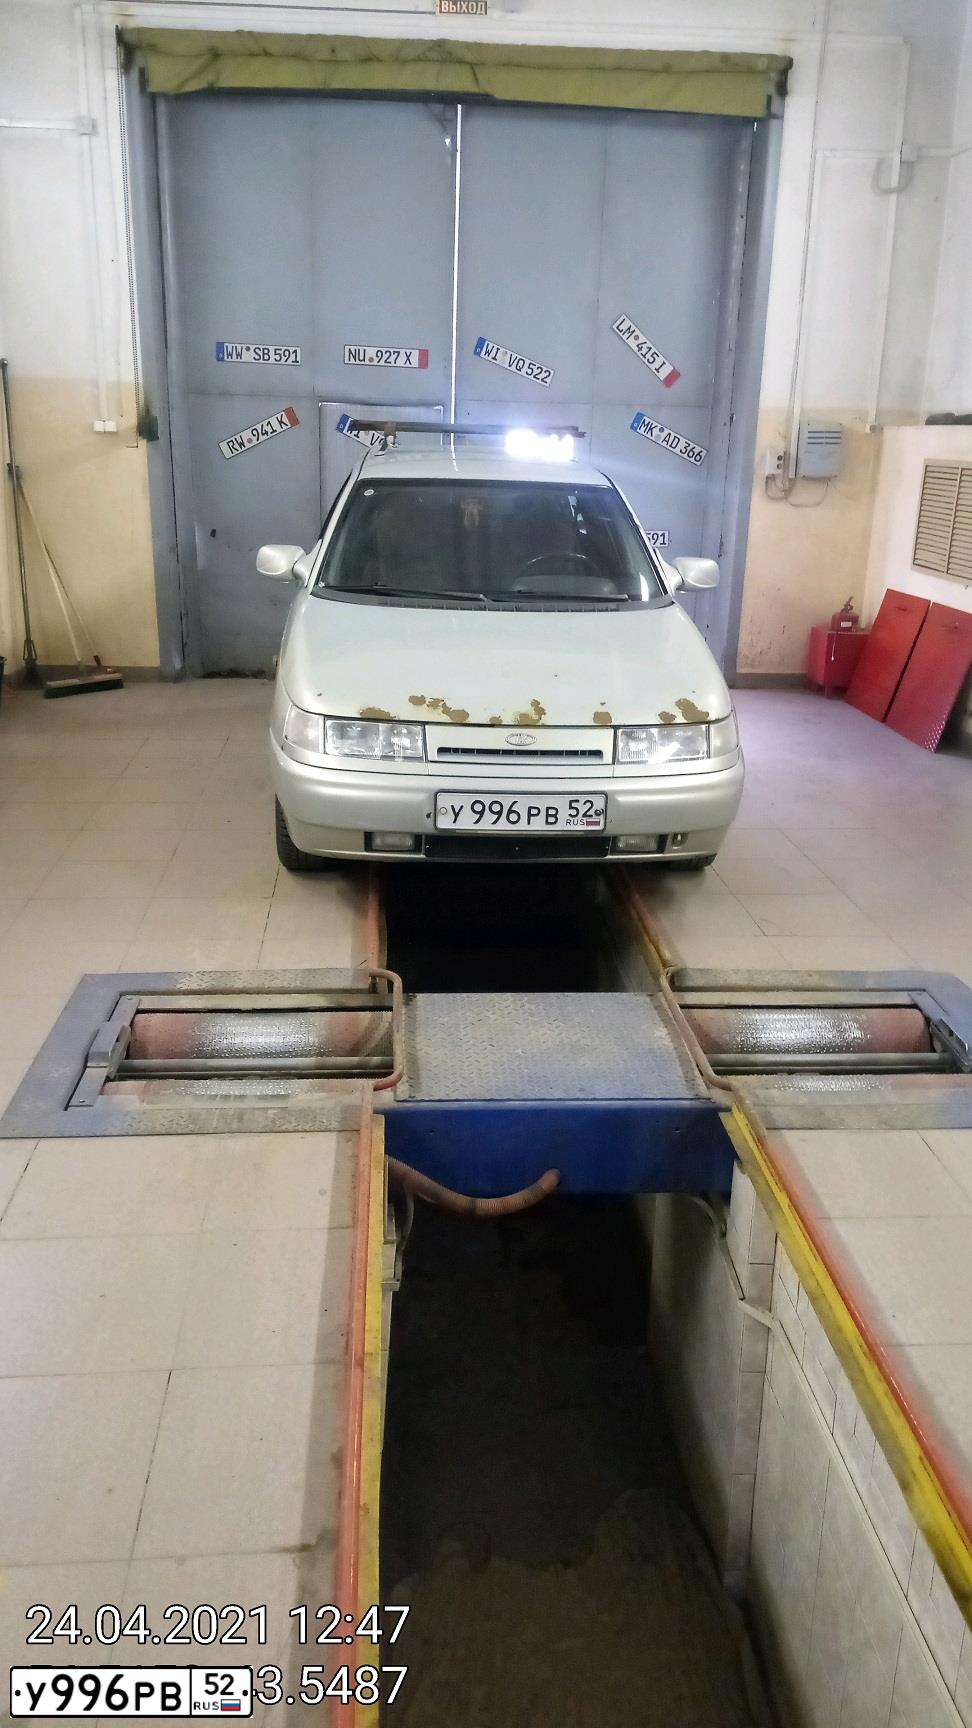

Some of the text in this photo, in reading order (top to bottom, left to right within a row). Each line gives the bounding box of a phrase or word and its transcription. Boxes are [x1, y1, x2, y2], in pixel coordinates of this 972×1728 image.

[441, 1, 486, 14] ВЫХОД
[375, 349, 401, 365] 927
[525, 362, 551, 384] 522
[251, 420, 278, 442] 941
[680, 441, 703, 463] 366
[567, 799, 595, 818] 52
[565, 818, 585, 826] RUS
